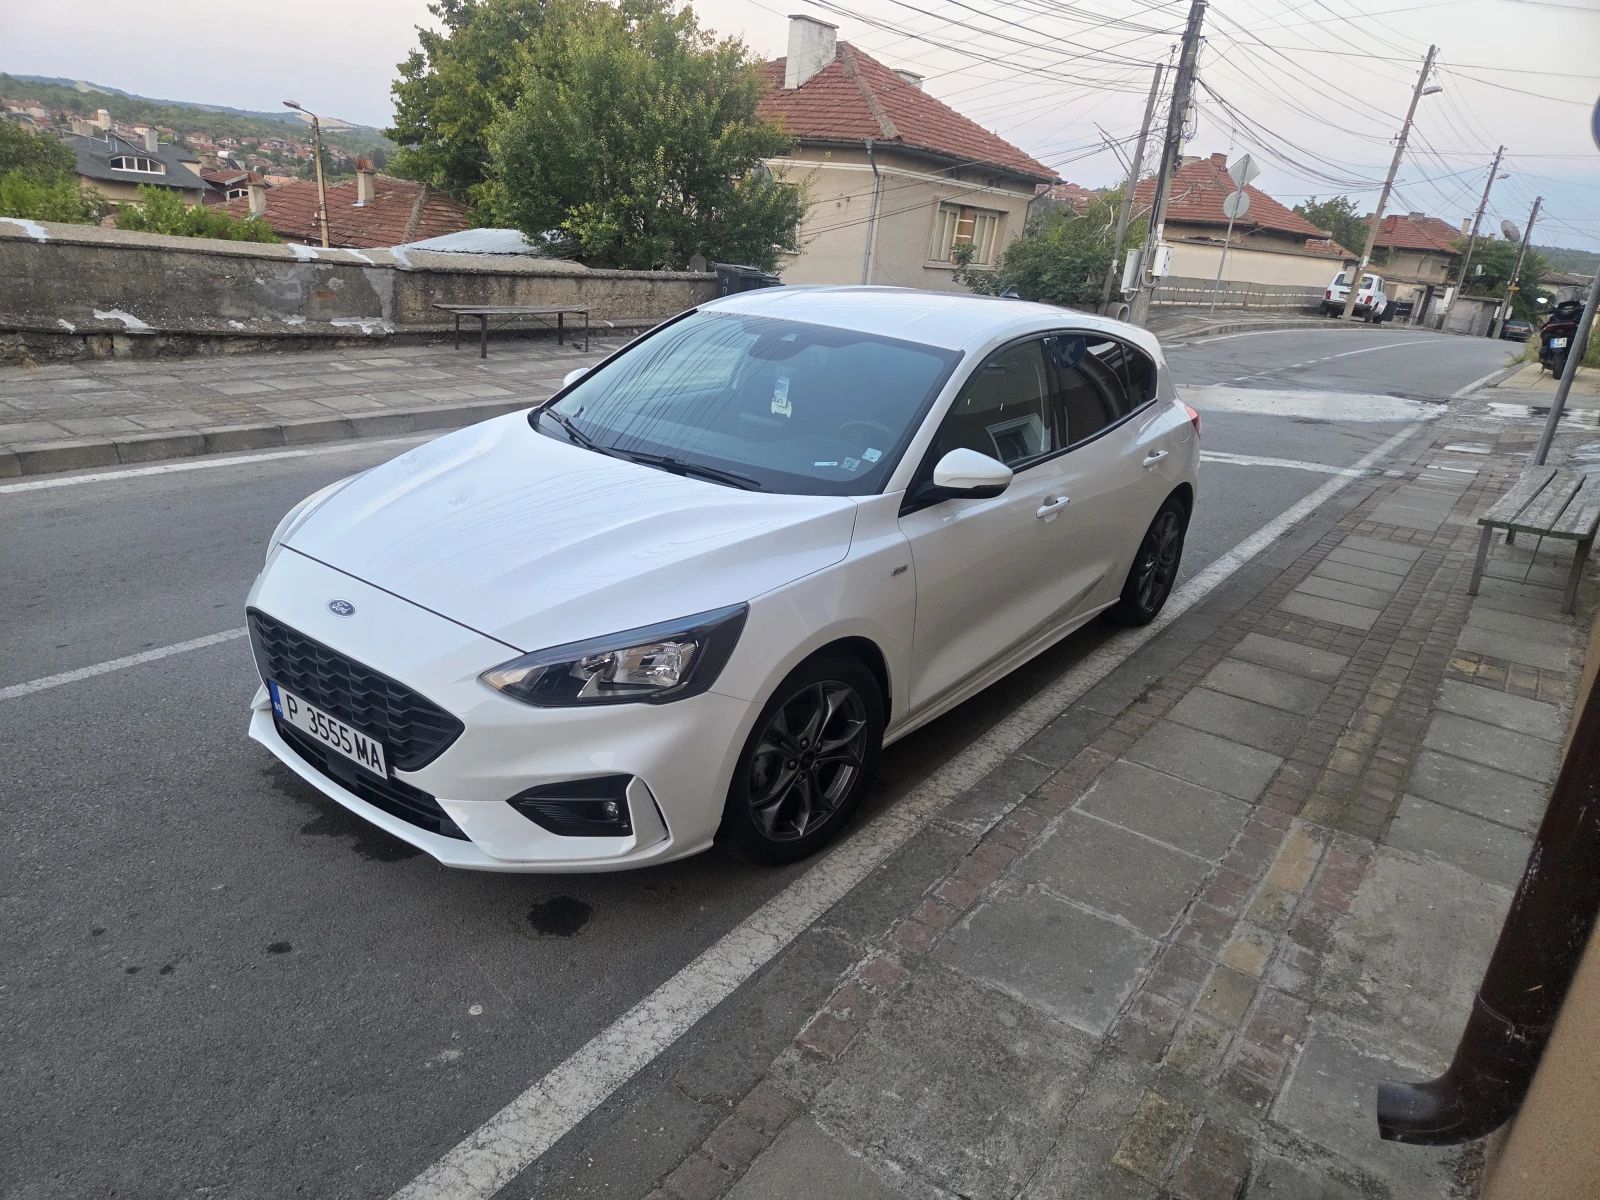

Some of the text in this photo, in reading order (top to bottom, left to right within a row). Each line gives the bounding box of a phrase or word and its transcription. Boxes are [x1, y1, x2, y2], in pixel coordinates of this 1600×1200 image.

[331, 601, 351, 614] Ford
[286, 693, 383, 773] P 3555 MA
